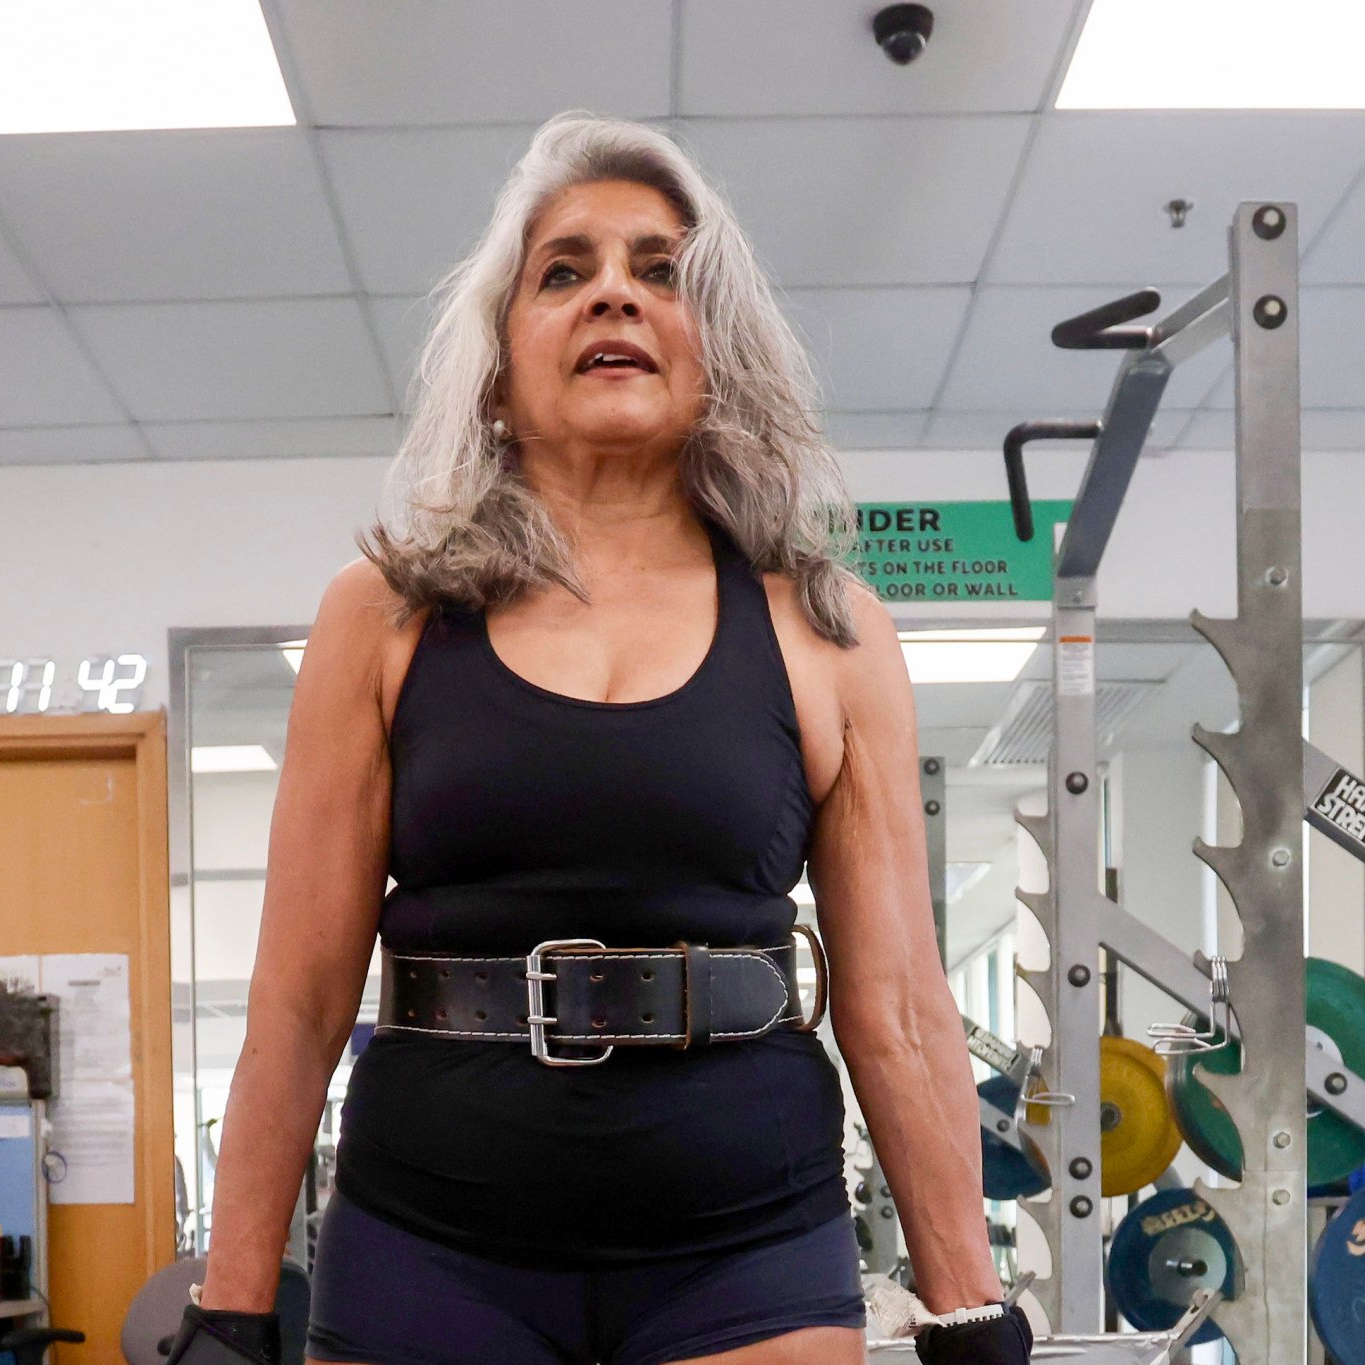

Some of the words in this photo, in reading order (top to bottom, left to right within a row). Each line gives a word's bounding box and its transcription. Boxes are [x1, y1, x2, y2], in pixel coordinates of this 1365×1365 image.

[918, 538, 954, 552] USE
[883, 561, 907, 575] ON
[913, 560, 945, 574] THE
[952, 560, 1008, 573] FLOOR
[932, 583, 959, 596] OR
[966, 582, 1018, 596] WALL
[77, 654, 148, 714] 42
